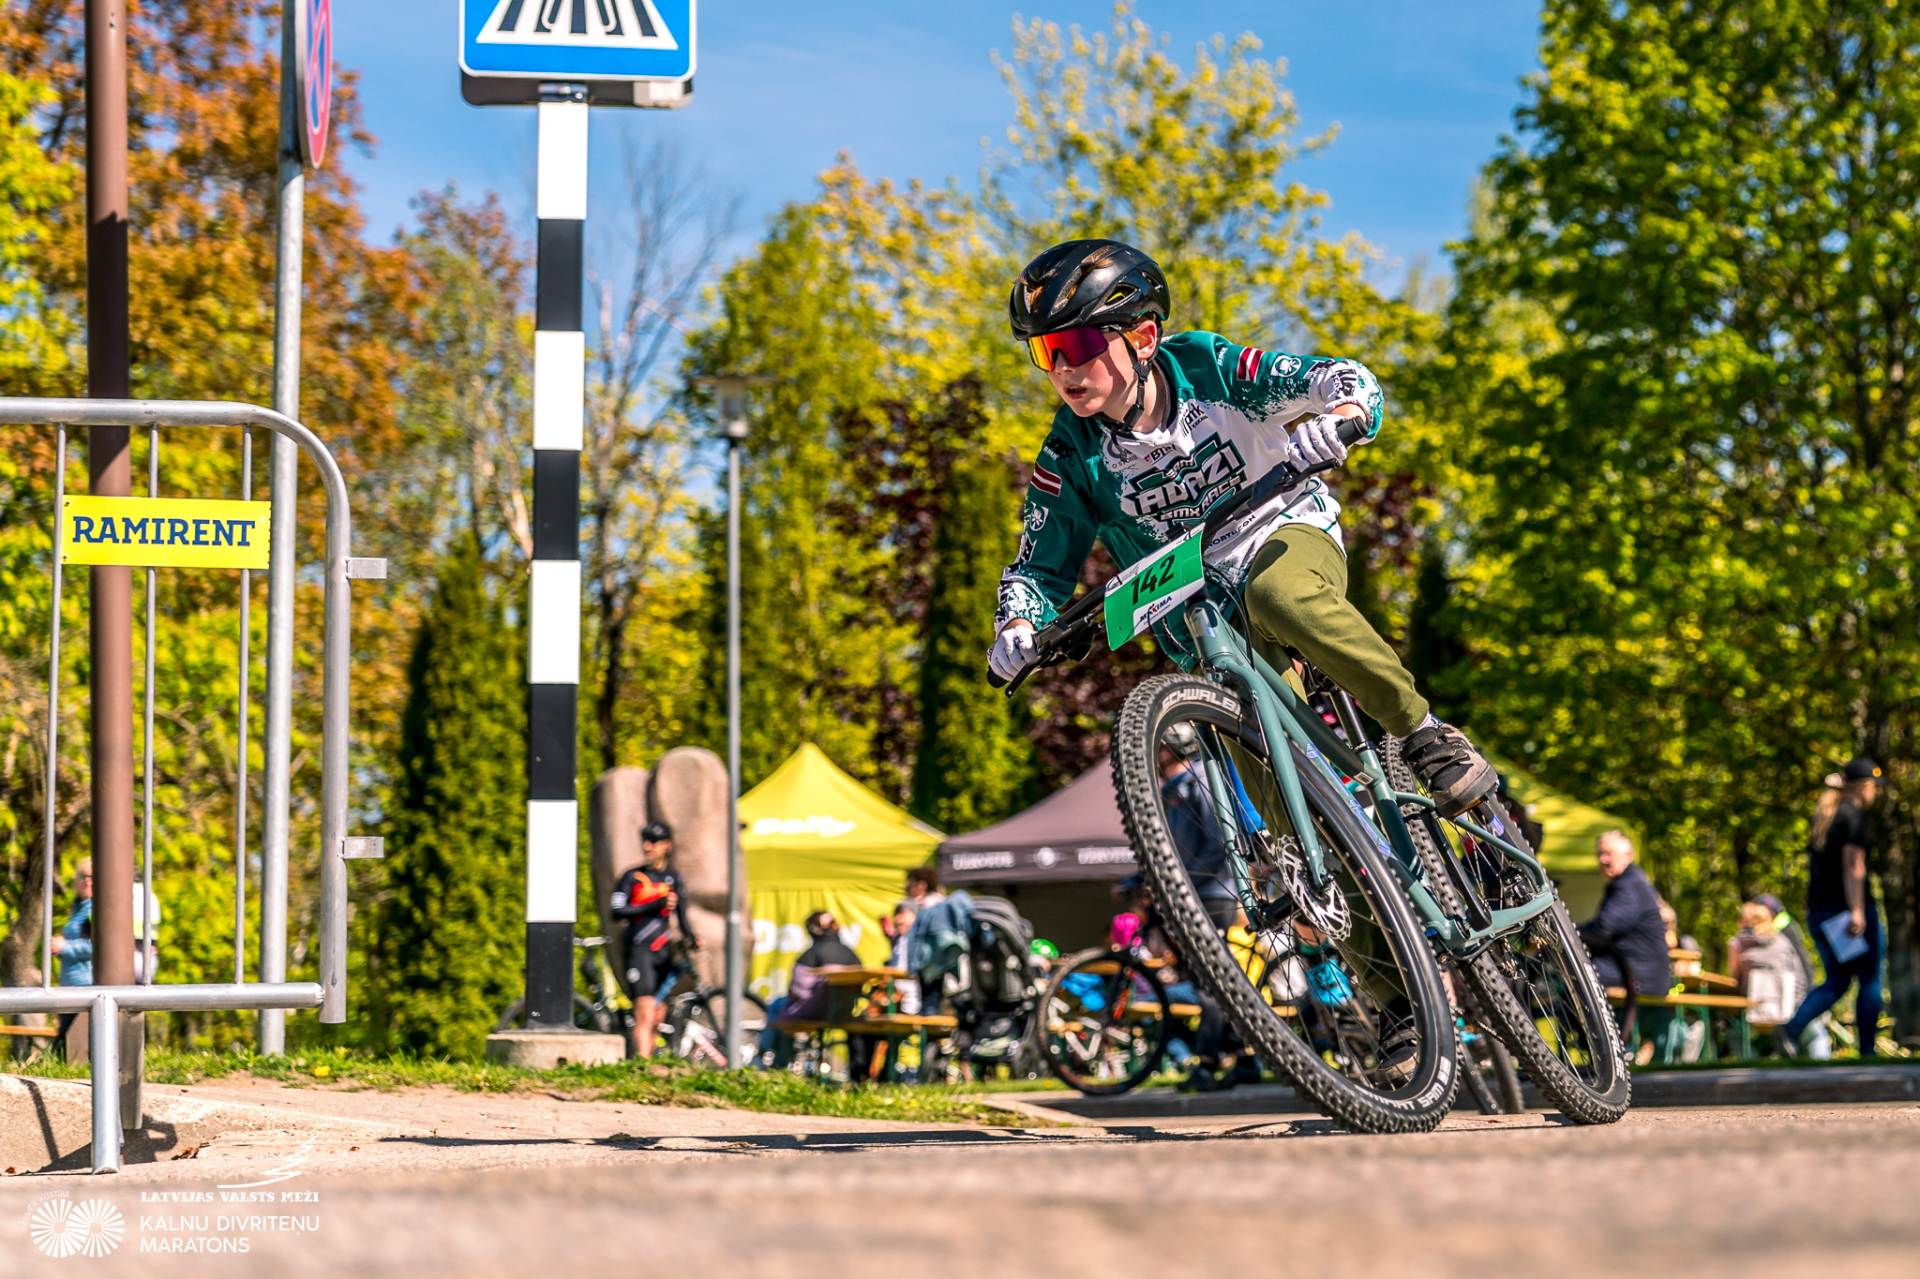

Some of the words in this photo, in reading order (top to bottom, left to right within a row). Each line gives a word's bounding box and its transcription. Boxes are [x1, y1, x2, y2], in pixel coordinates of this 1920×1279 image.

[1201, 475, 1241, 512] RACE
[72, 516, 256, 547] RAMIRENT
[1130, 554, 1176, 606] 142
[1162, 688, 1241, 715] SCHWALB
[1584, 962, 1625, 1081] SCHWALBE
[1416, 1082, 1445, 1108] SAM
